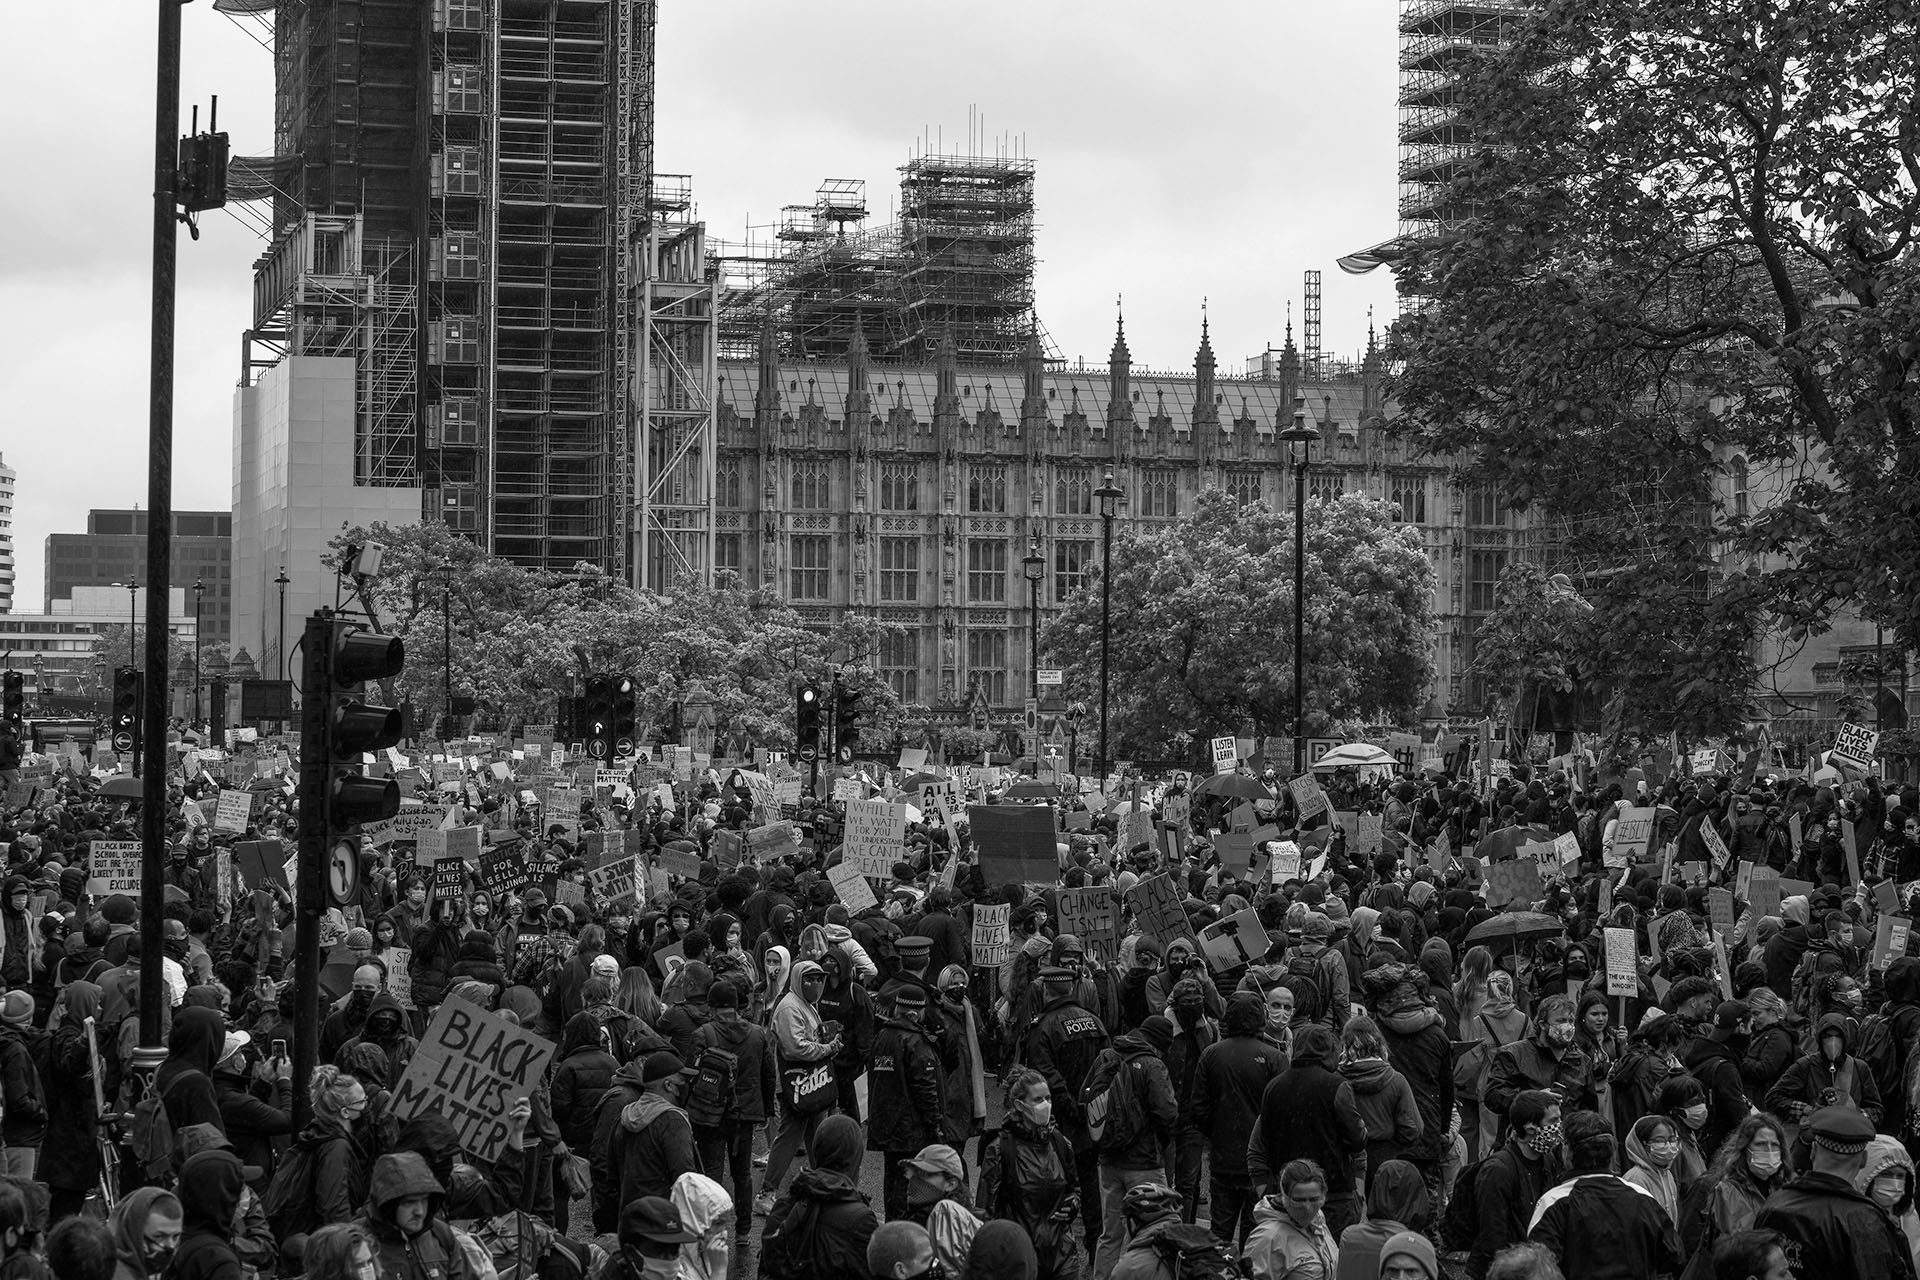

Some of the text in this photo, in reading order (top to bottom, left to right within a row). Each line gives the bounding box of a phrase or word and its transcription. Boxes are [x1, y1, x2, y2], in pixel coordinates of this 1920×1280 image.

[1842, 724, 1875, 743] BLACK
[1215, 739, 1234, 750] LISTEN
[1839, 734, 1868, 751] LIVES
[1216, 750, 1234, 761] LEARN
[1315, 744, 1328, 761] P
[596, 776, 627, 784] MATTER
[924, 796, 956, 807] LIES
[396, 807, 421, 816] acist
[852, 802, 895, 817] WHILE
[924, 804, 960, 816] MAER
[848, 816, 898, 828] WE WAIT
[814, 822, 844, 838] BLA
[856, 826, 890, 837] FOR YOU
[1618, 819, 1652, 842] #BLM
[95, 843, 117, 851] BLACK
[120, 843, 134, 851] BOYS
[420, 838, 441, 848] BELLY
[862, 836, 904, 846] UNDERSTAND
[94, 851, 120, 859] SCHOOL
[416, 850, 445, 859] MUJINGA
[480, 844, 520, 866] JUSTICE
[847, 844, 866, 856] WE
[94, 860, 106, 868] BUT
[110, 860, 120, 868] ARE
[1530, 852, 1556, 864] BLM
[436, 862, 460, 873] BLACK
[493, 858, 512, 874] FOR
[526, 862, 560, 875] SILENCE
[845, 856, 900, 875] EATH
[92, 869, 134, 879] LIKELY TO BE
[436, 873, 461, 884] LIVES
[486, 864, 520, 886] BELLY
[533, 874, 544, 884] IS
[594, 871, 602, 884] I
[490, 874, 530, 896] MUJINGA
[436, 886, 464, 898] MATTER
[1126, 875, 1178, 916] BLACK
[1060, 892, 1109, 917] CHANGE
[976, 904, 1008, 924] BLACK
[1068, 916, 1110, 938] ISN'T
[974, 924, 1005, 944] LIVES
[1155, 920, 1197, 949] ATTER
[975, 944, 1009, 966] MATTER
[392, 965, 407, 976] KILL
[1066, 1021, 1096, 1034] POLICE
[439, 1009, 546, 1086] BLACK
[434, 1055, 512, 1116] LIVES
[784, 1065, 833, 1104] Patta
[390, 1078, 508, 1160] MATTER
